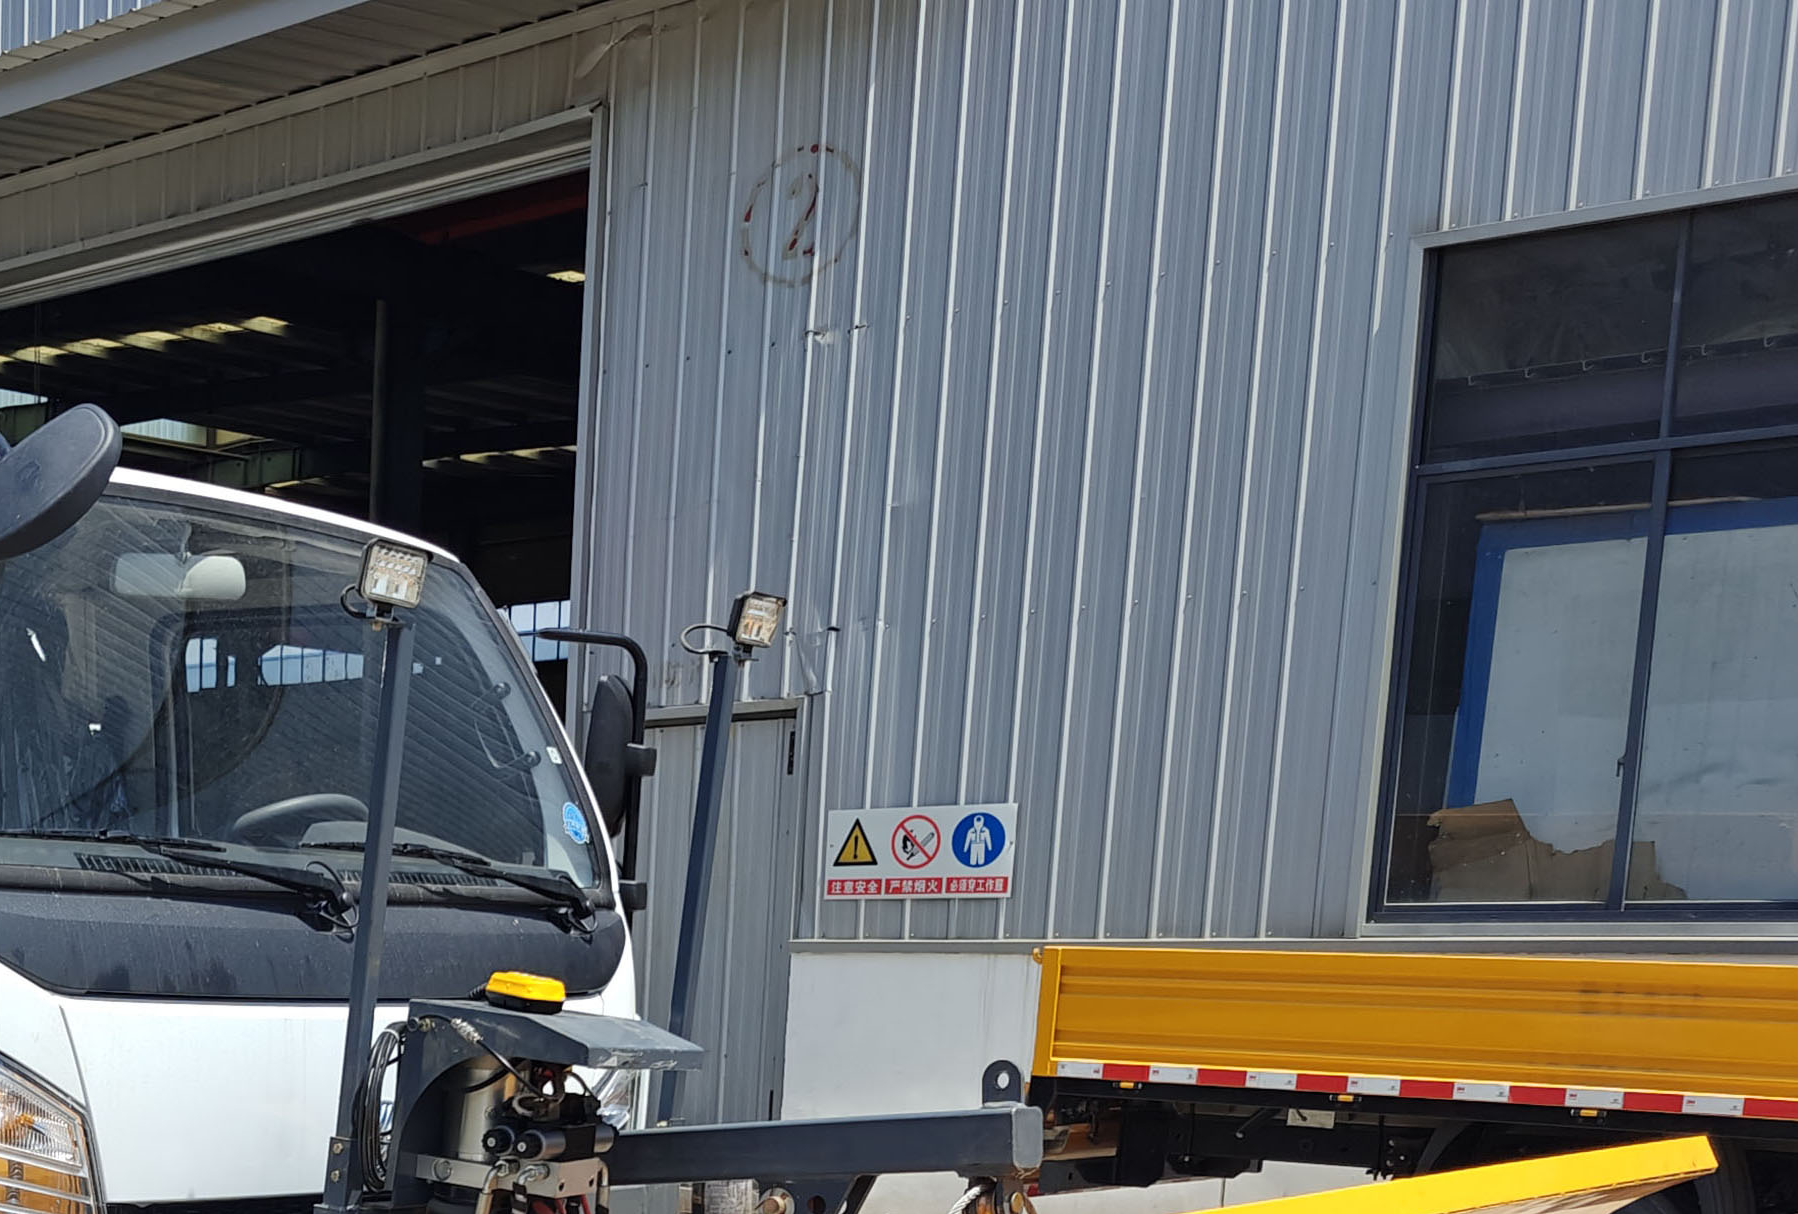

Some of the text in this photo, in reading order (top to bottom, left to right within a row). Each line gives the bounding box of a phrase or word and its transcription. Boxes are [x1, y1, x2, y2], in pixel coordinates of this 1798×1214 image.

[831, 880, 879, 894] 注意安全
[888, 879, 939, 894] 严禁烟火
